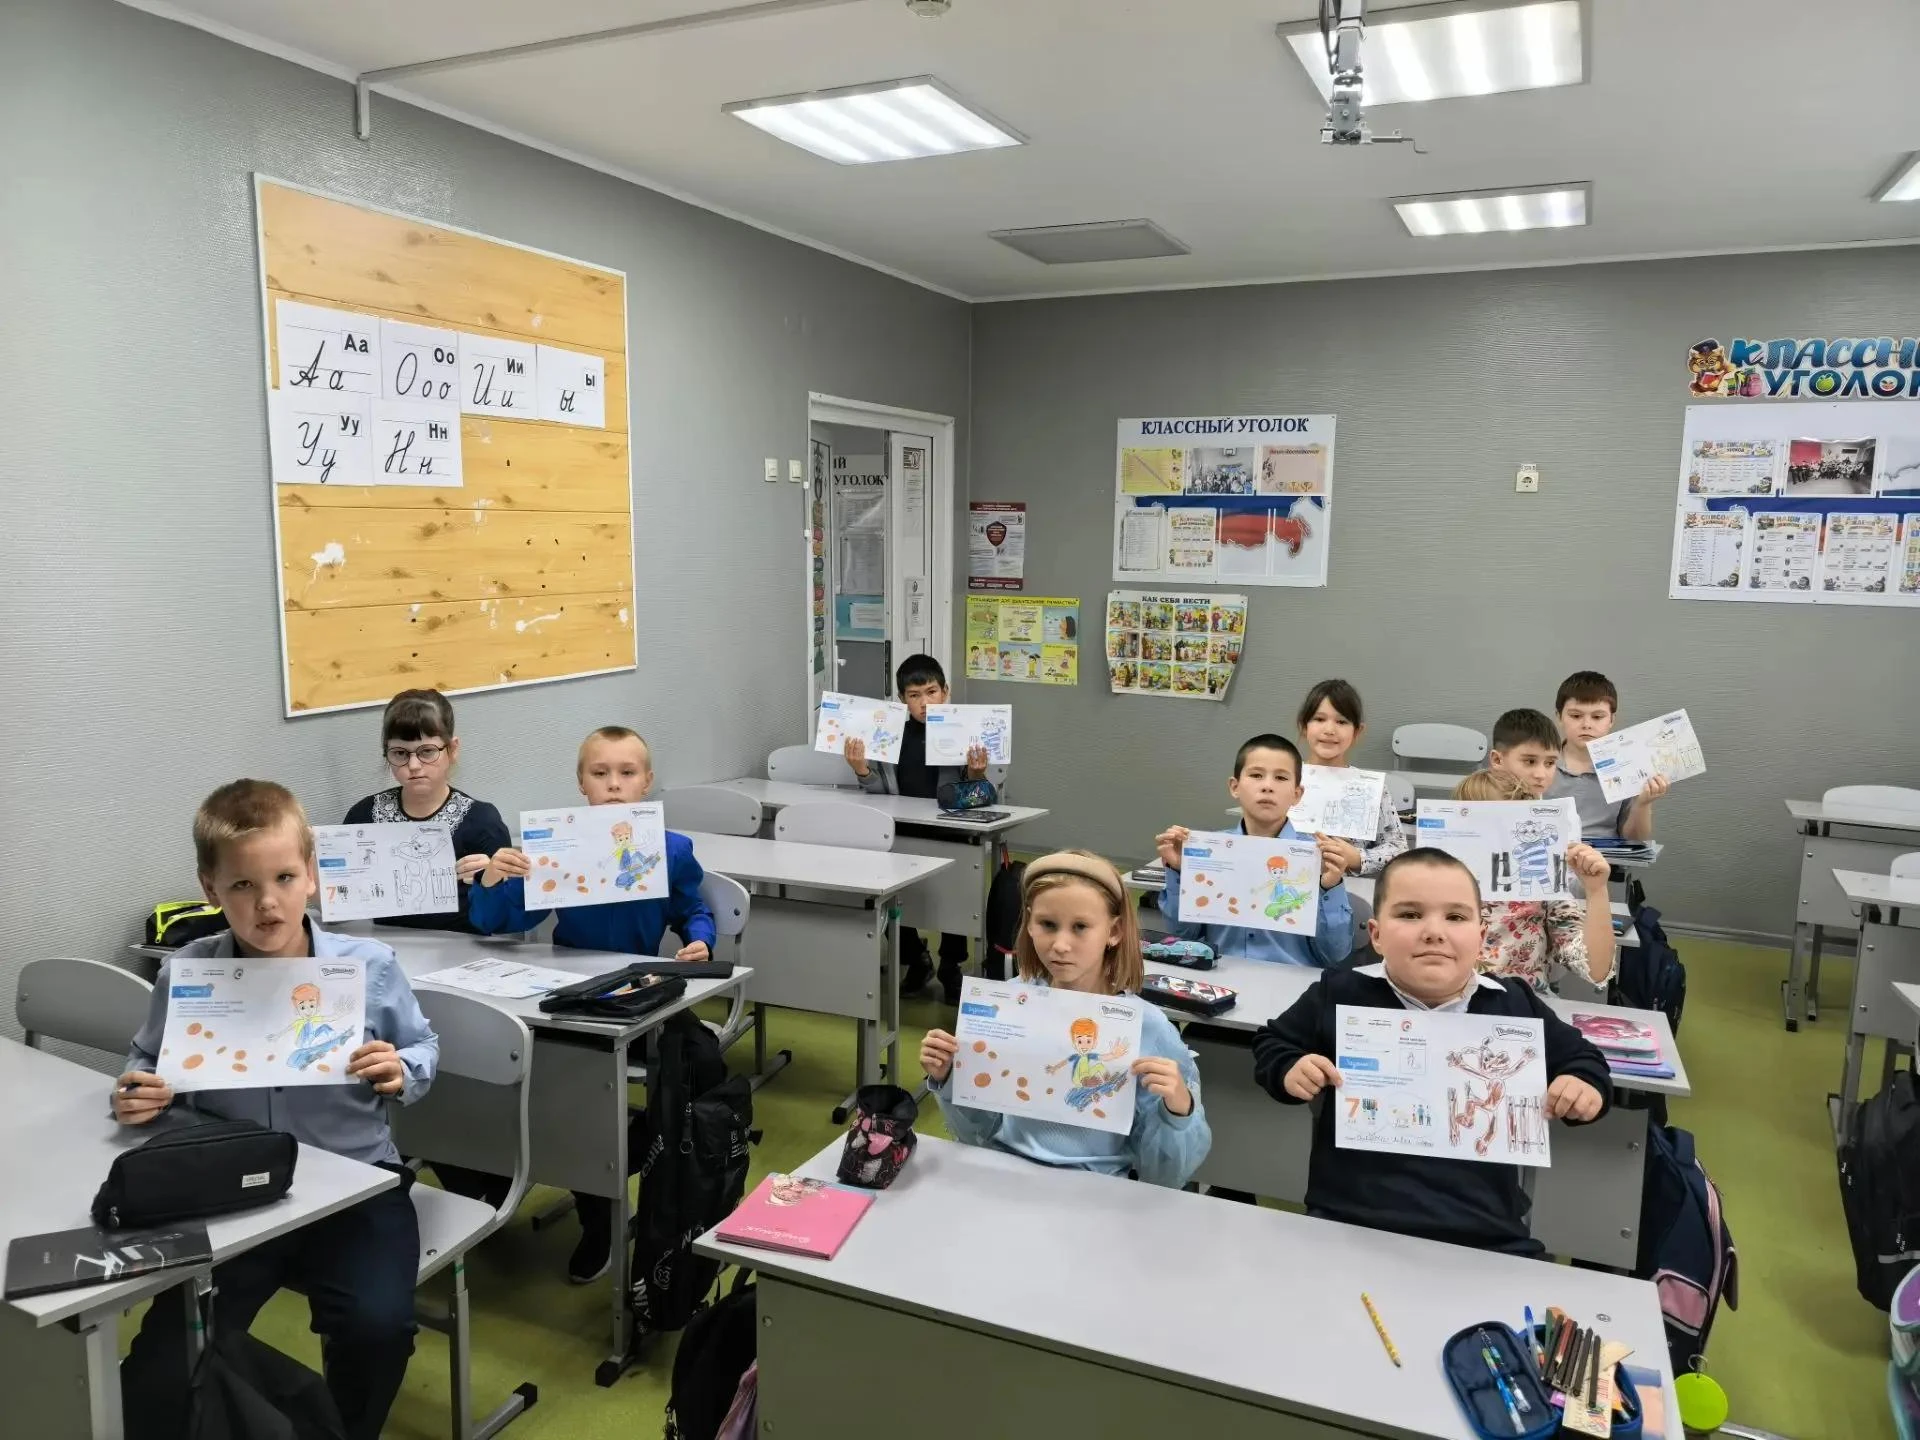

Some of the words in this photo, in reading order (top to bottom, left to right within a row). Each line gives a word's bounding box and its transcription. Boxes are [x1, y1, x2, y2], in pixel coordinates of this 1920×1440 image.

[343, 334, 369, 354] Аа
[433, 347, 456, 365] Оо
[1730, 339, 1920, 370] КЛАССН
[506, 359, 525, 375] Ии
[340, 416, 361, 435] Уу
[429, 424, 449, 441] Нн
[1141, 417, 1236, 435] КЛАССНЫЙ
[1238, 417, 1309, 433] УГОЛОК
